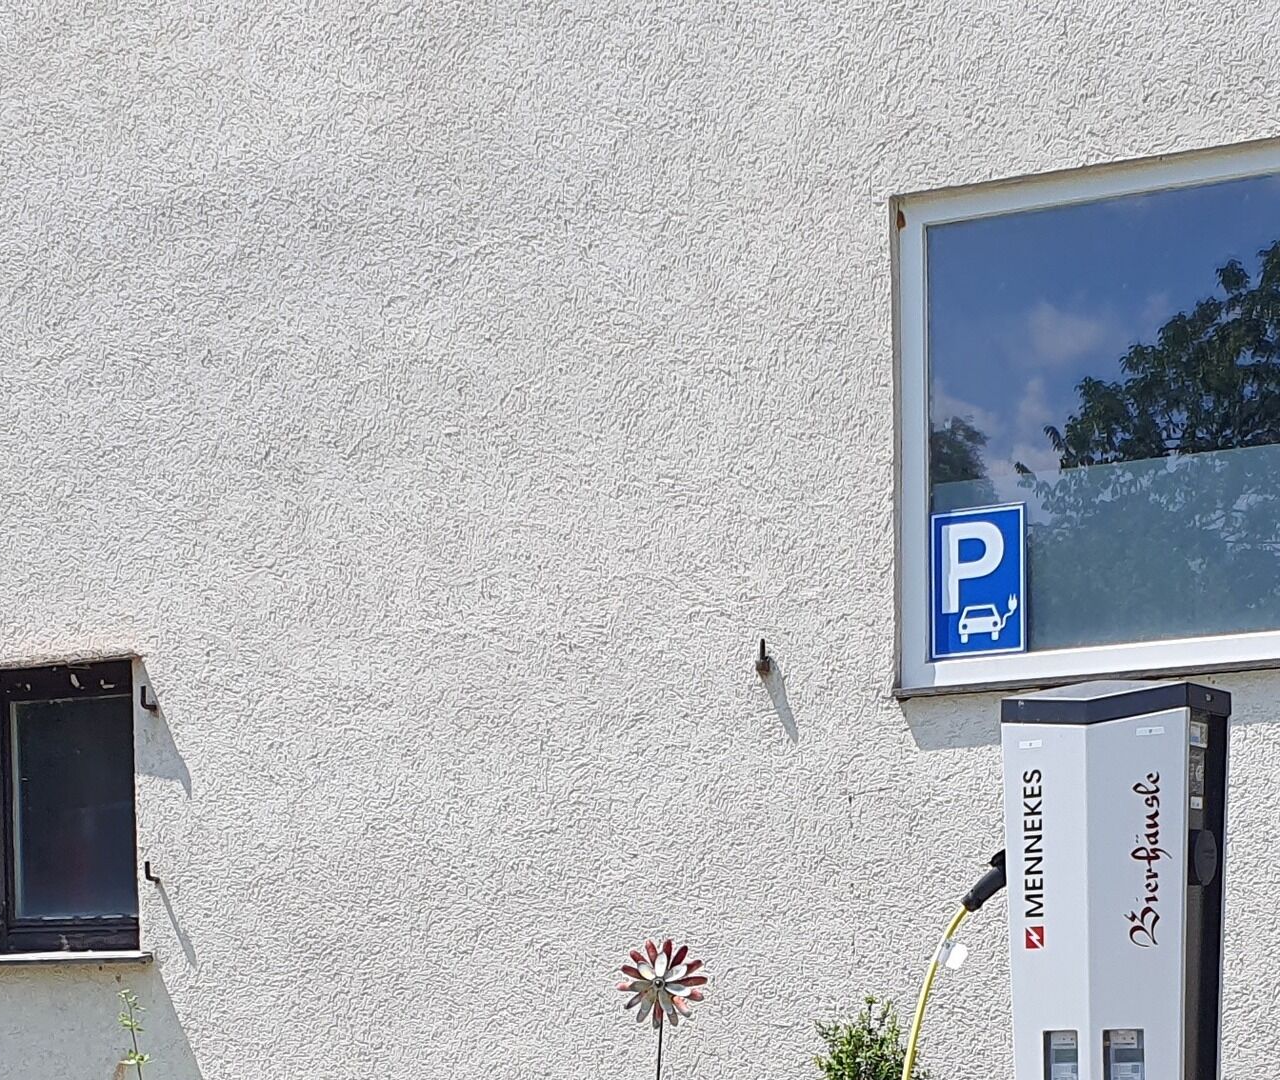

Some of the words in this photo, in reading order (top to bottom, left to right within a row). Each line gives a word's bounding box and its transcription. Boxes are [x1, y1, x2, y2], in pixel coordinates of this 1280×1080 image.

[940, 521, 1005, 614] P
[1022, 768, 1045, 919] MENNEKES
[1123, 770, 1174, 949] Bierhäusle
